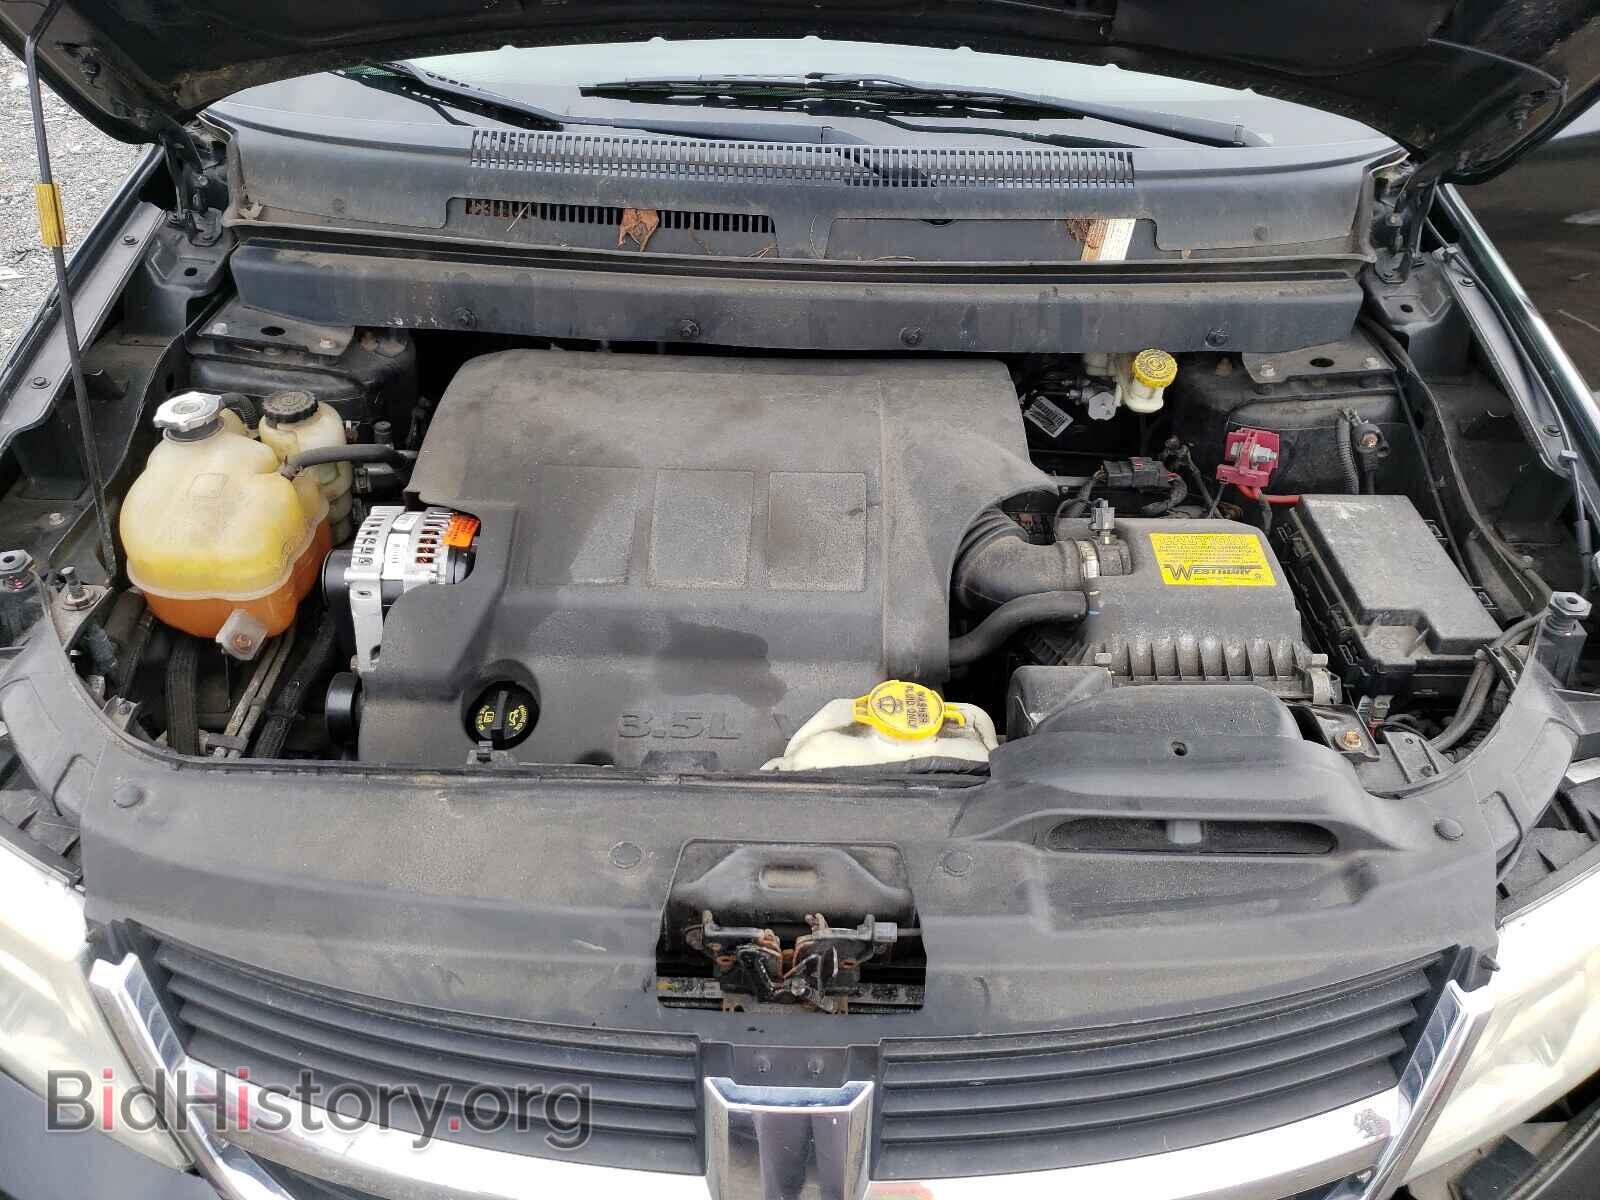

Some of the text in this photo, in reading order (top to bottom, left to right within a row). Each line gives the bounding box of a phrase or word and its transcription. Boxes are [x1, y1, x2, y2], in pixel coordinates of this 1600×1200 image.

[907, 708, 919, 729] ONLY
[916, 691, 929, 724] WASHER
[617, 712, 740, 740] 3.5L
